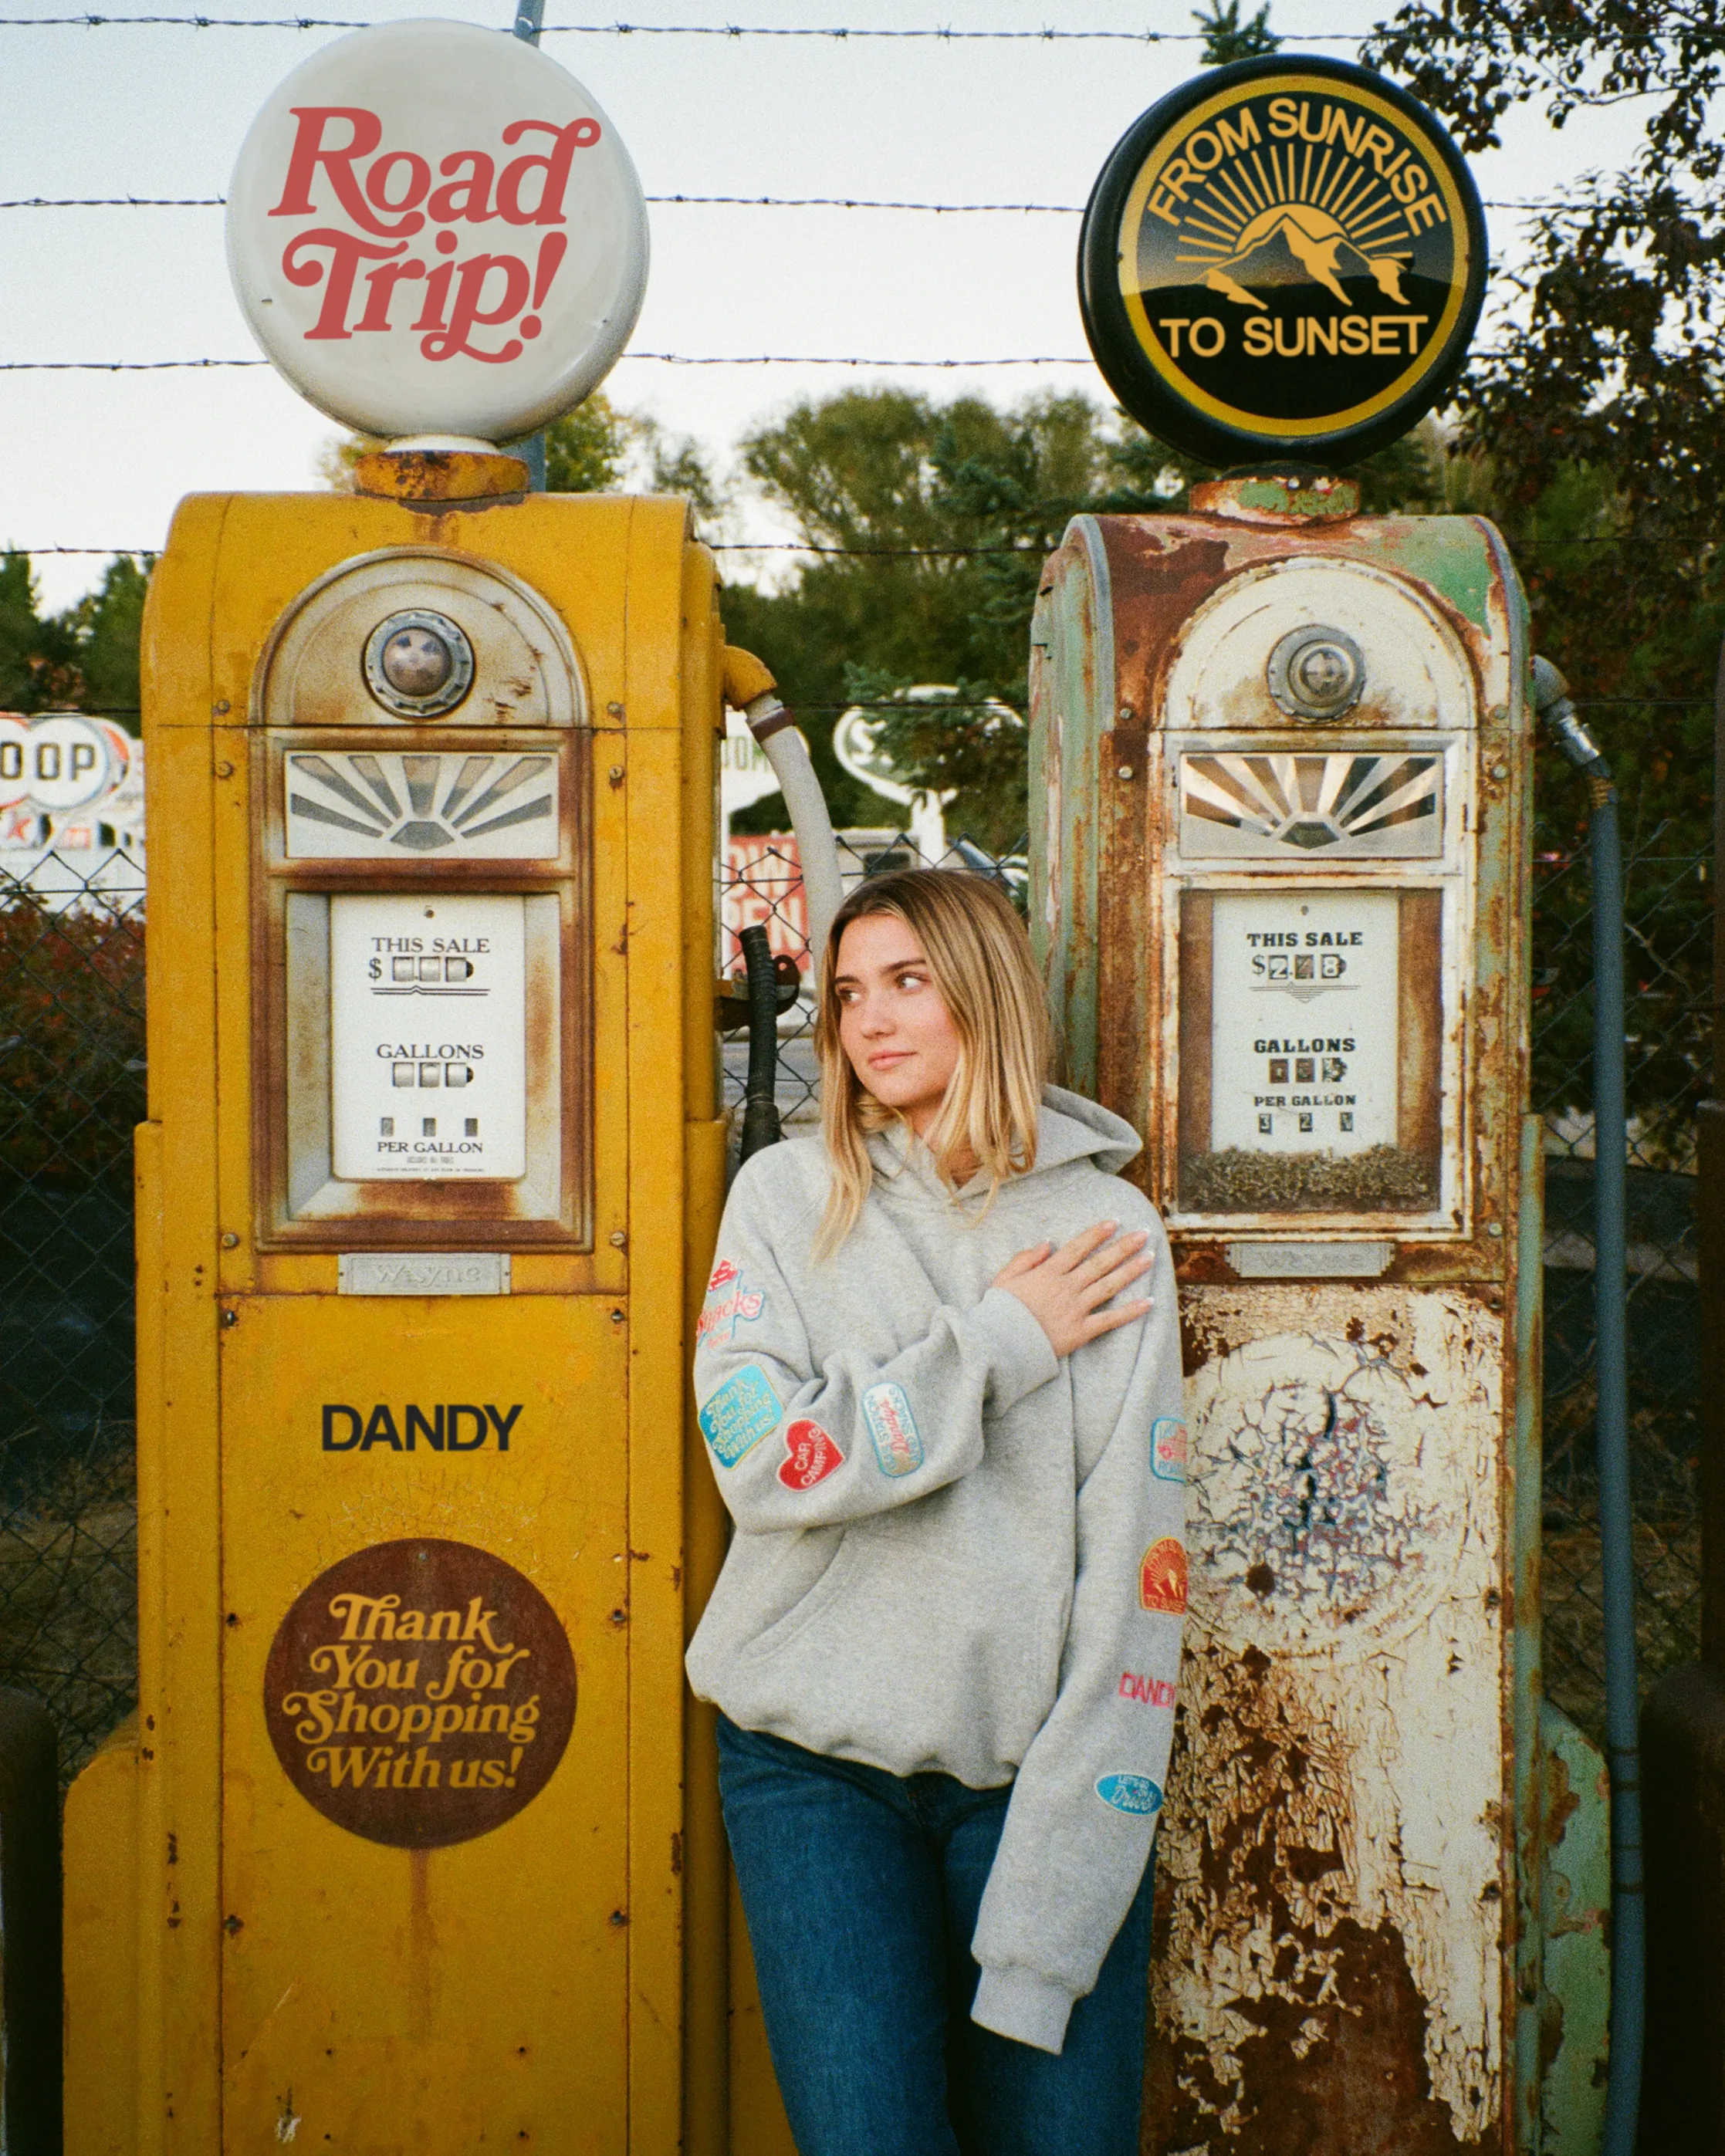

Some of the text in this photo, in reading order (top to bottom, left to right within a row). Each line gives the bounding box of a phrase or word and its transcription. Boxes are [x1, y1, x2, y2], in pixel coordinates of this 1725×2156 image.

[268, 107, 601, 238] Road
[1147, 98, 1447, 236] FROM SUNRISE
[282, 228, 568, 363] Trip!
[1159, 316, 1429, 357] TO SUNSET
[371, 938, 490, 953] THIS SALE
[1246, 931, 1363, 947] THIS SALE
[377, 1044, 484, 1059] GALLONS
[1253, 1038, 1356, 1053] GALLONS
[1253, 1095, 1357, 1107] PER GALLON
[377, 1142, 483, 1154] PER GALLON
[322, 1404, 523, 1451] DANDY
[793, 1442, 812, 1471] CAR
[800, 1425, 827, 1486] CAMPING
[329, 1593, 513, 1654] Thank
[309, 1644, 530, 1701] You for
[282, 1690, 539, 1744] Shopping
[306, 1745, 524, 1789] With us!
